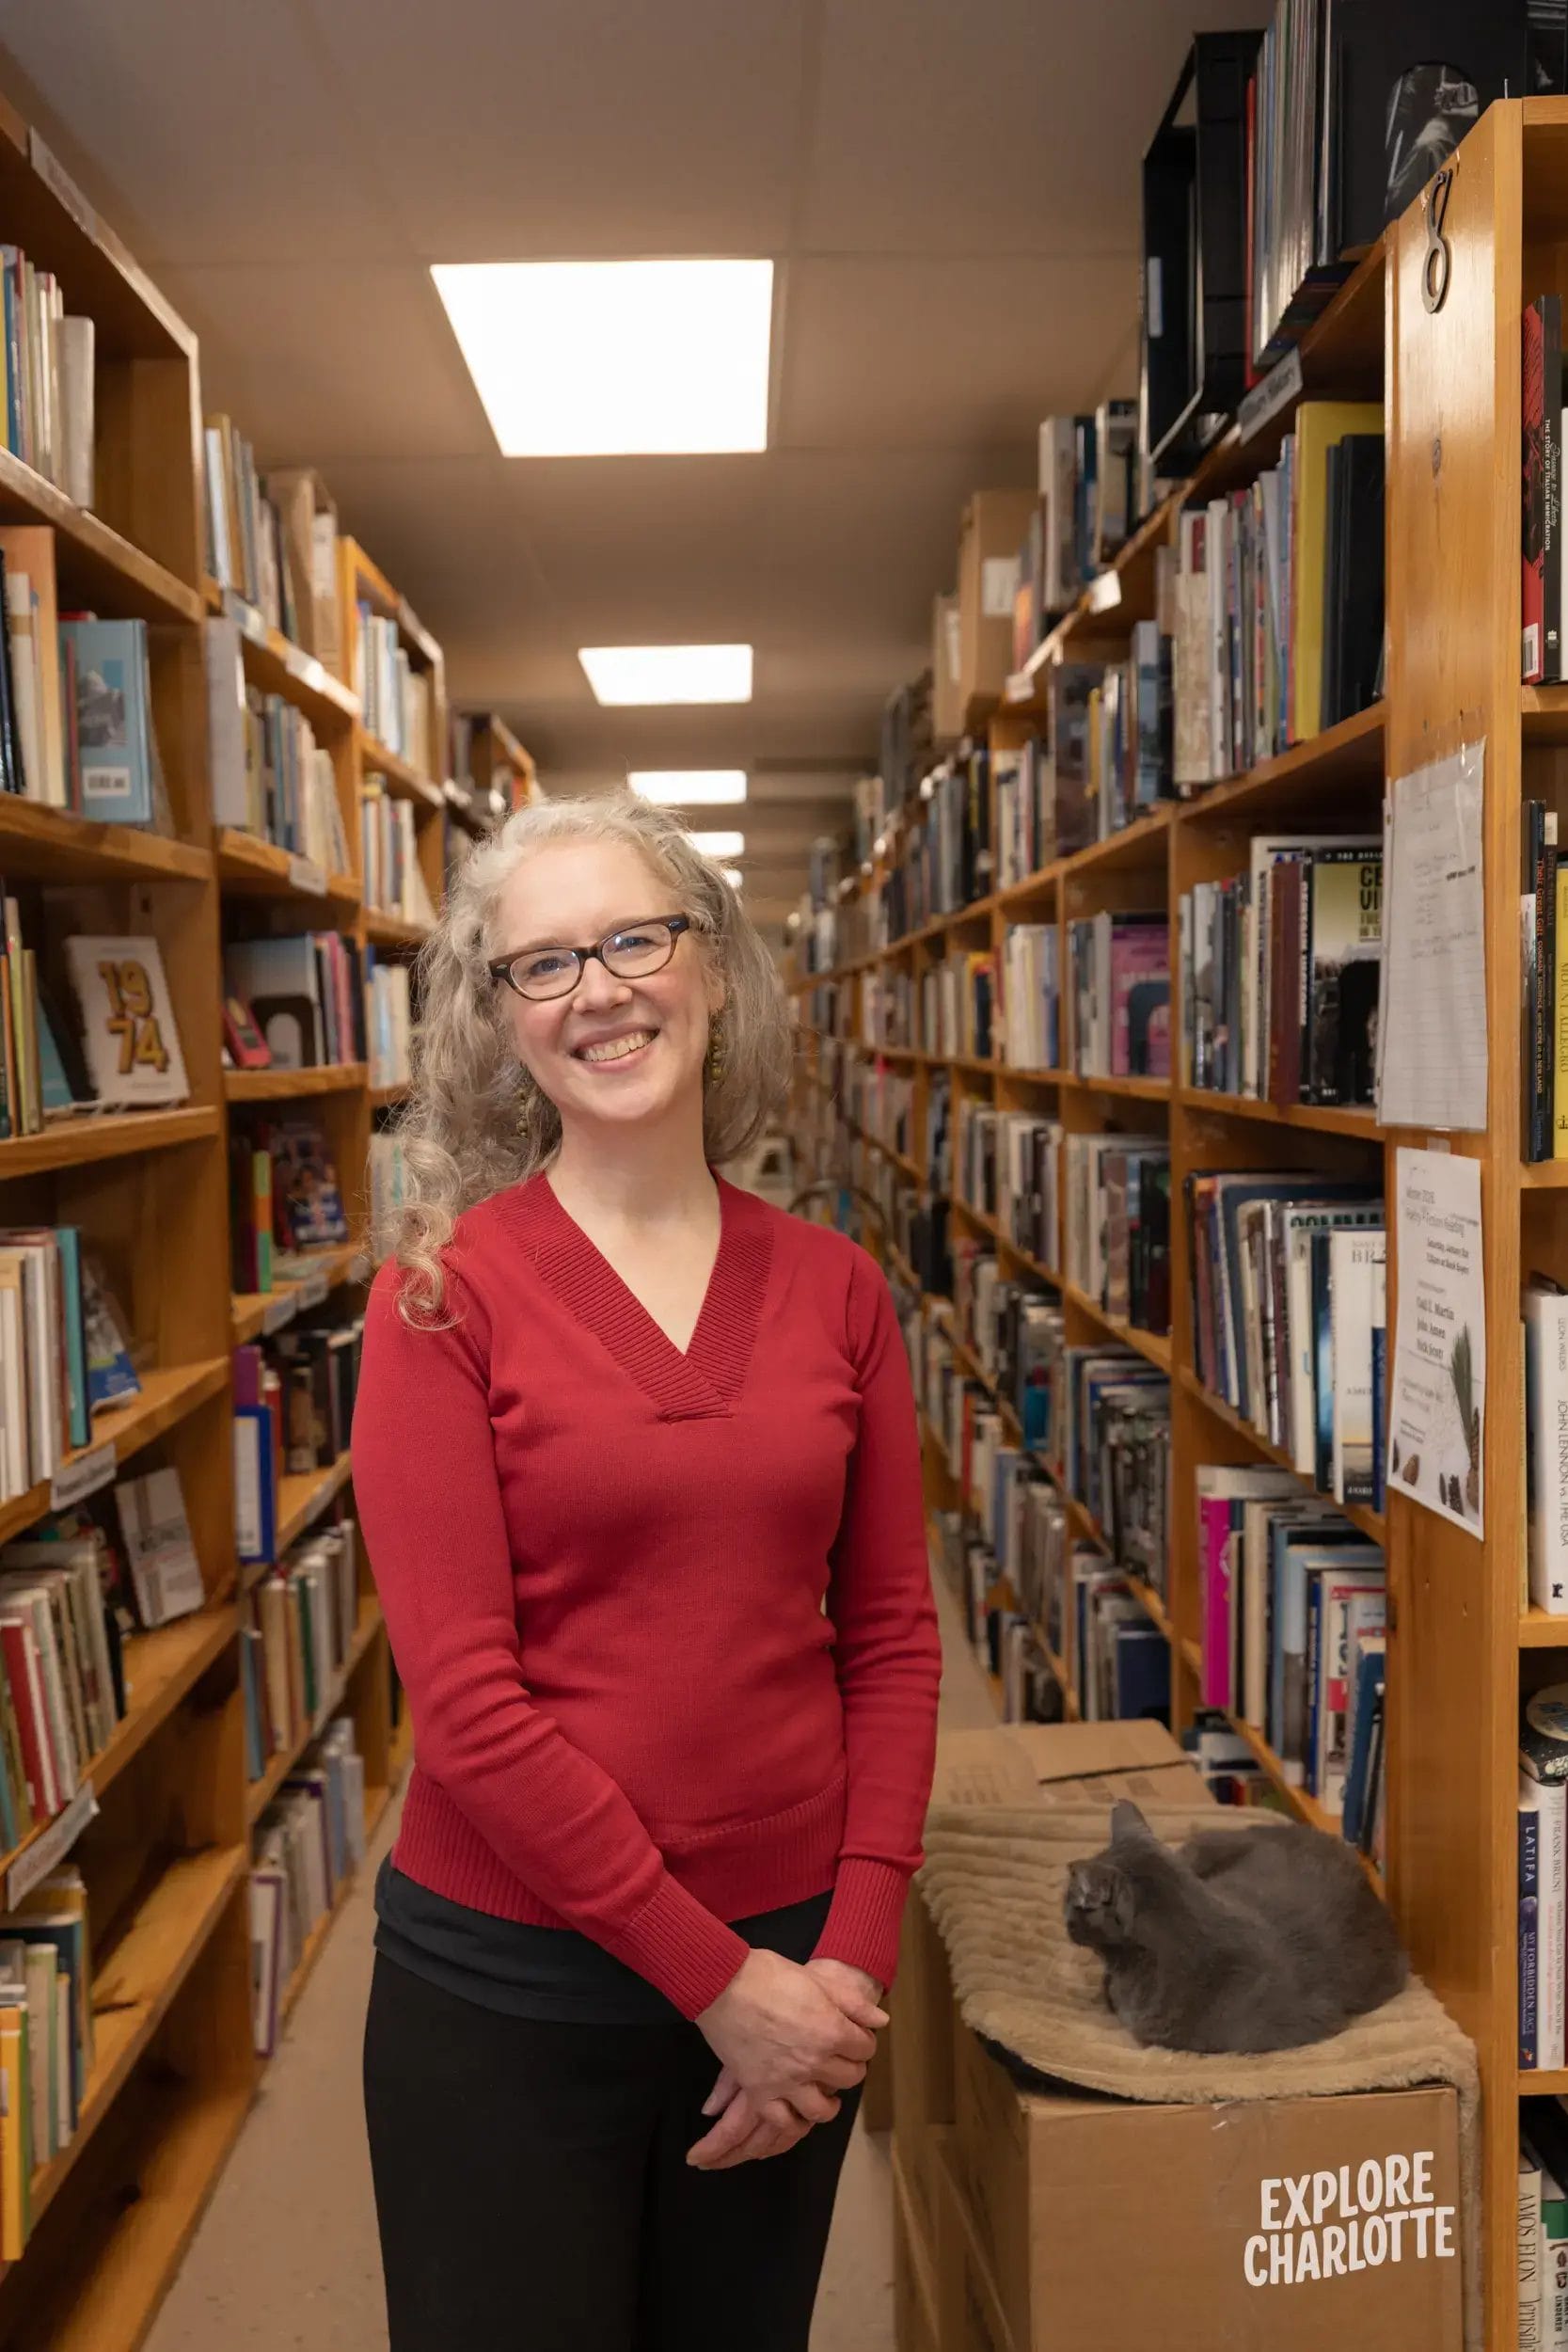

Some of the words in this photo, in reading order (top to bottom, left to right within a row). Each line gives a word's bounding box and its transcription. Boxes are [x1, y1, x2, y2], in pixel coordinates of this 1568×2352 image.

[1544, 460, 1551, 469] OF
[1536, 858, 1544, 885] Their
[98, 960, 153, 1017] 19
[106, 1015, 171, 1074] 74
[1558, 1317, 1566, 1340] LEON
[1558, 1400, 1568, 1431] JOHN
[1559, 1434, 1568, 1483] LENNON
[1560, 1502, 1568, 1522] THE
[1560, 1524, 1568, 1547] USA
[1525, 1826, 1536, 1882] LATIFA
[1552, 1820, 1562, 1857] FRANK
[1551, 1859, 1562, 1893] BRUNI
[1528, 1931, 1535, 1946] MY
[1527, 2011, 1535, 2034] FACE
[1517, 2192, 1537, 2237] AMOS
[1517, 2243, 1537, 2282] ELON
[1555, 2296, 1563, 2332] LINDERER
